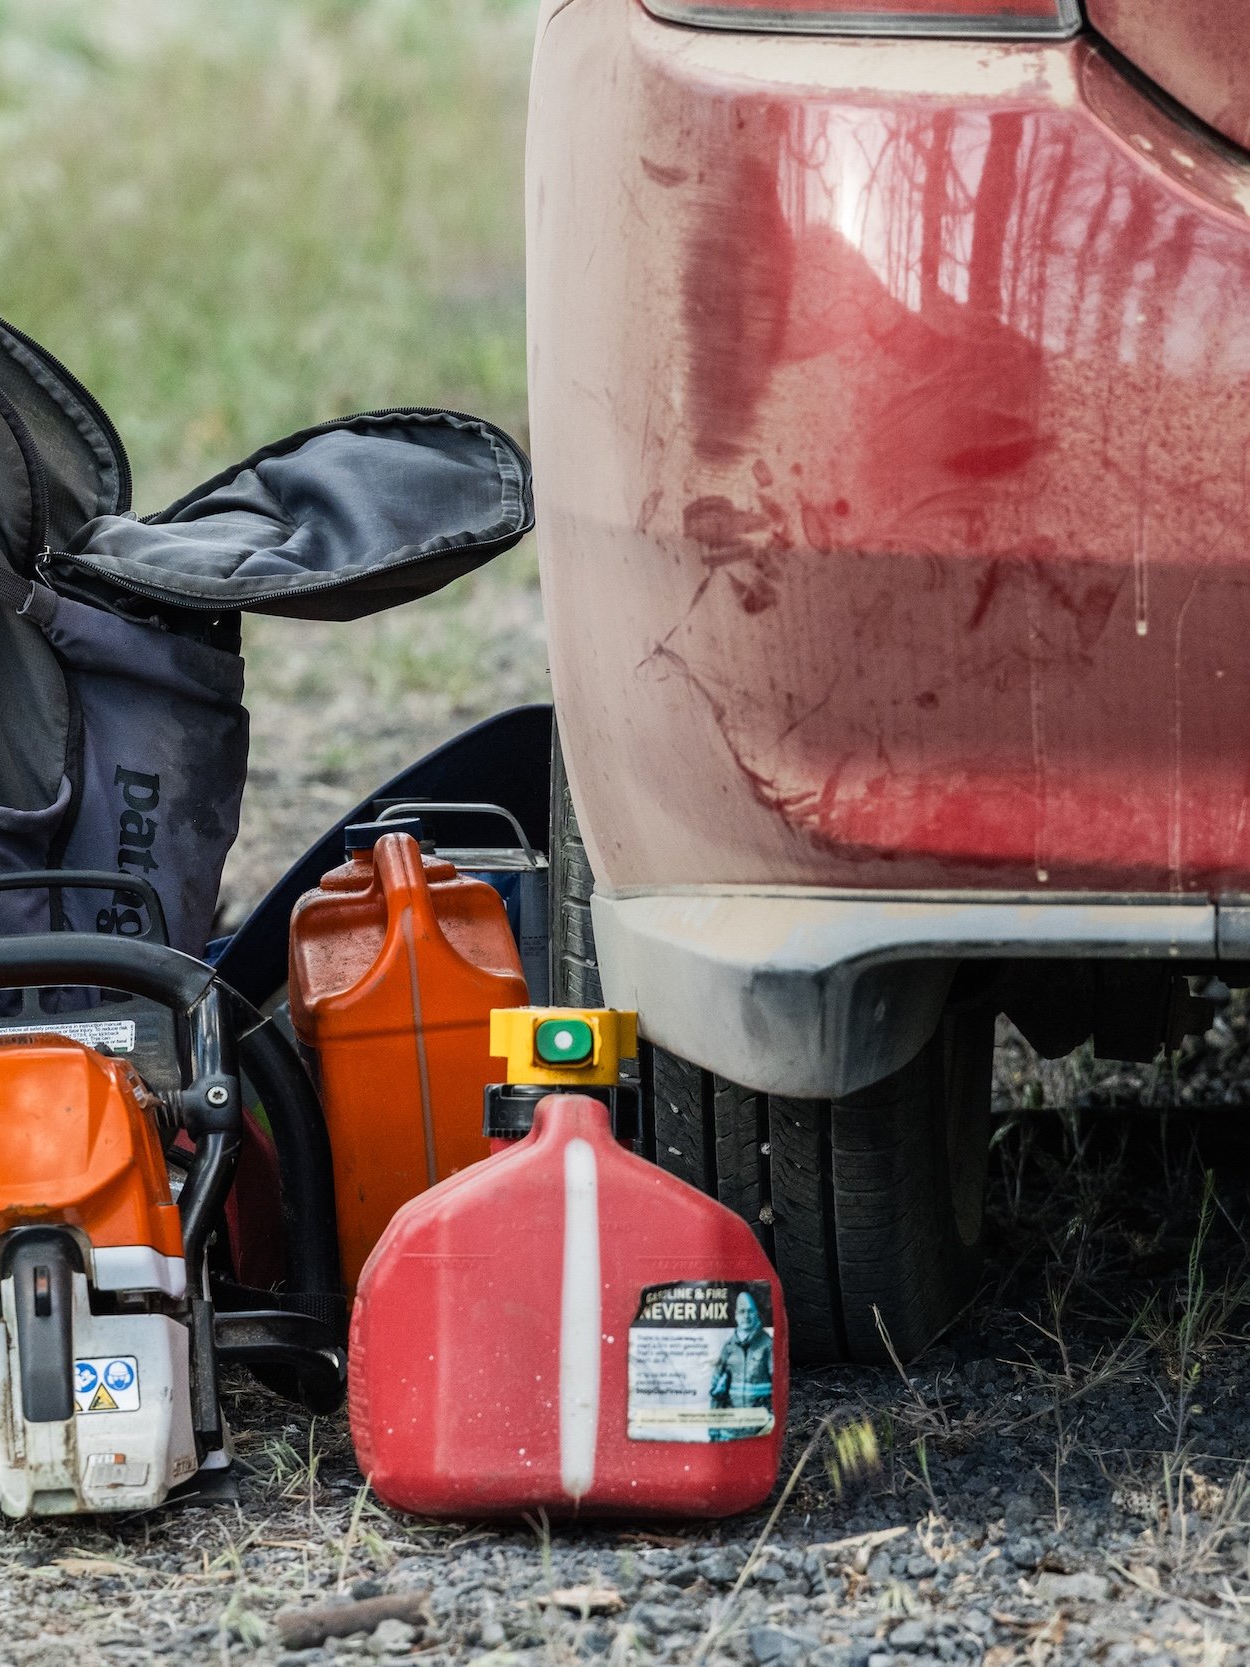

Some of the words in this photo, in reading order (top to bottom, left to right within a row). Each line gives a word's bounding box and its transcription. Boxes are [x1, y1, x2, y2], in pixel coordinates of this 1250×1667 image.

[705, 1287, 728, 1300] FIRE
[639, 1302, 697, 1320] NEVER
[700, 1302, 728, 1320] MIX
